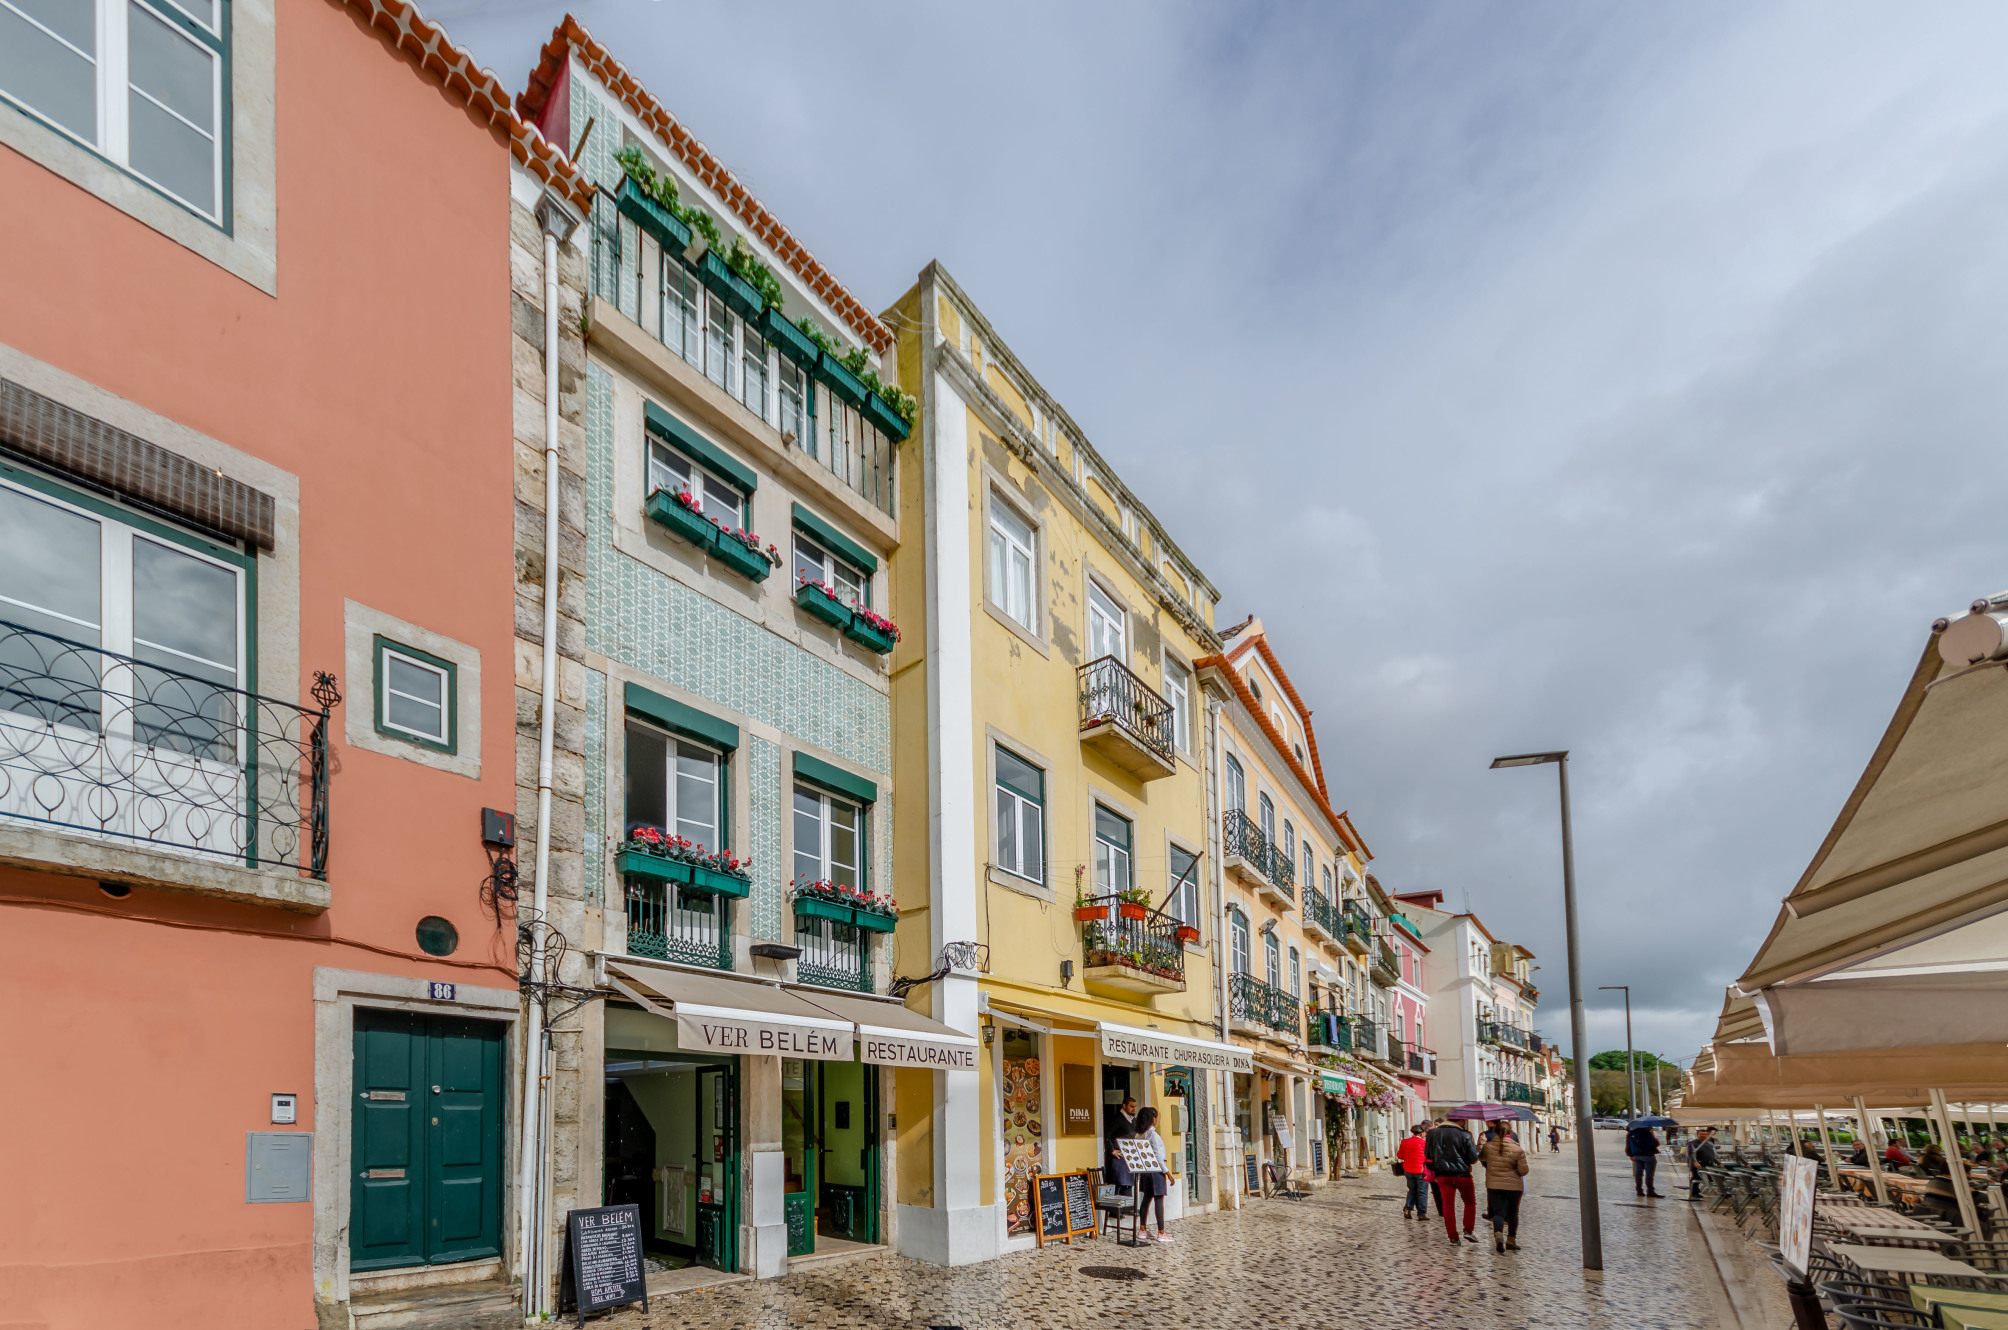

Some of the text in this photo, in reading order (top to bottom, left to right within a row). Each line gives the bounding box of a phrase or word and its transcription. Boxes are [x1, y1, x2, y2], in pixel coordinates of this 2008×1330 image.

[434, 983, 451, 999] 86
[701, 1024, 837, 1054] VER BELÉM
[868, 1041, 974, 1066] RESTAURANTE
[1109, 1038, 1250, 1069] RESTAURANTE CHURRASQUEIRA DINA
[1069, 1108, 1090, 1120] DINA
[579, 1211, 633, 1227] VER BELÉM
